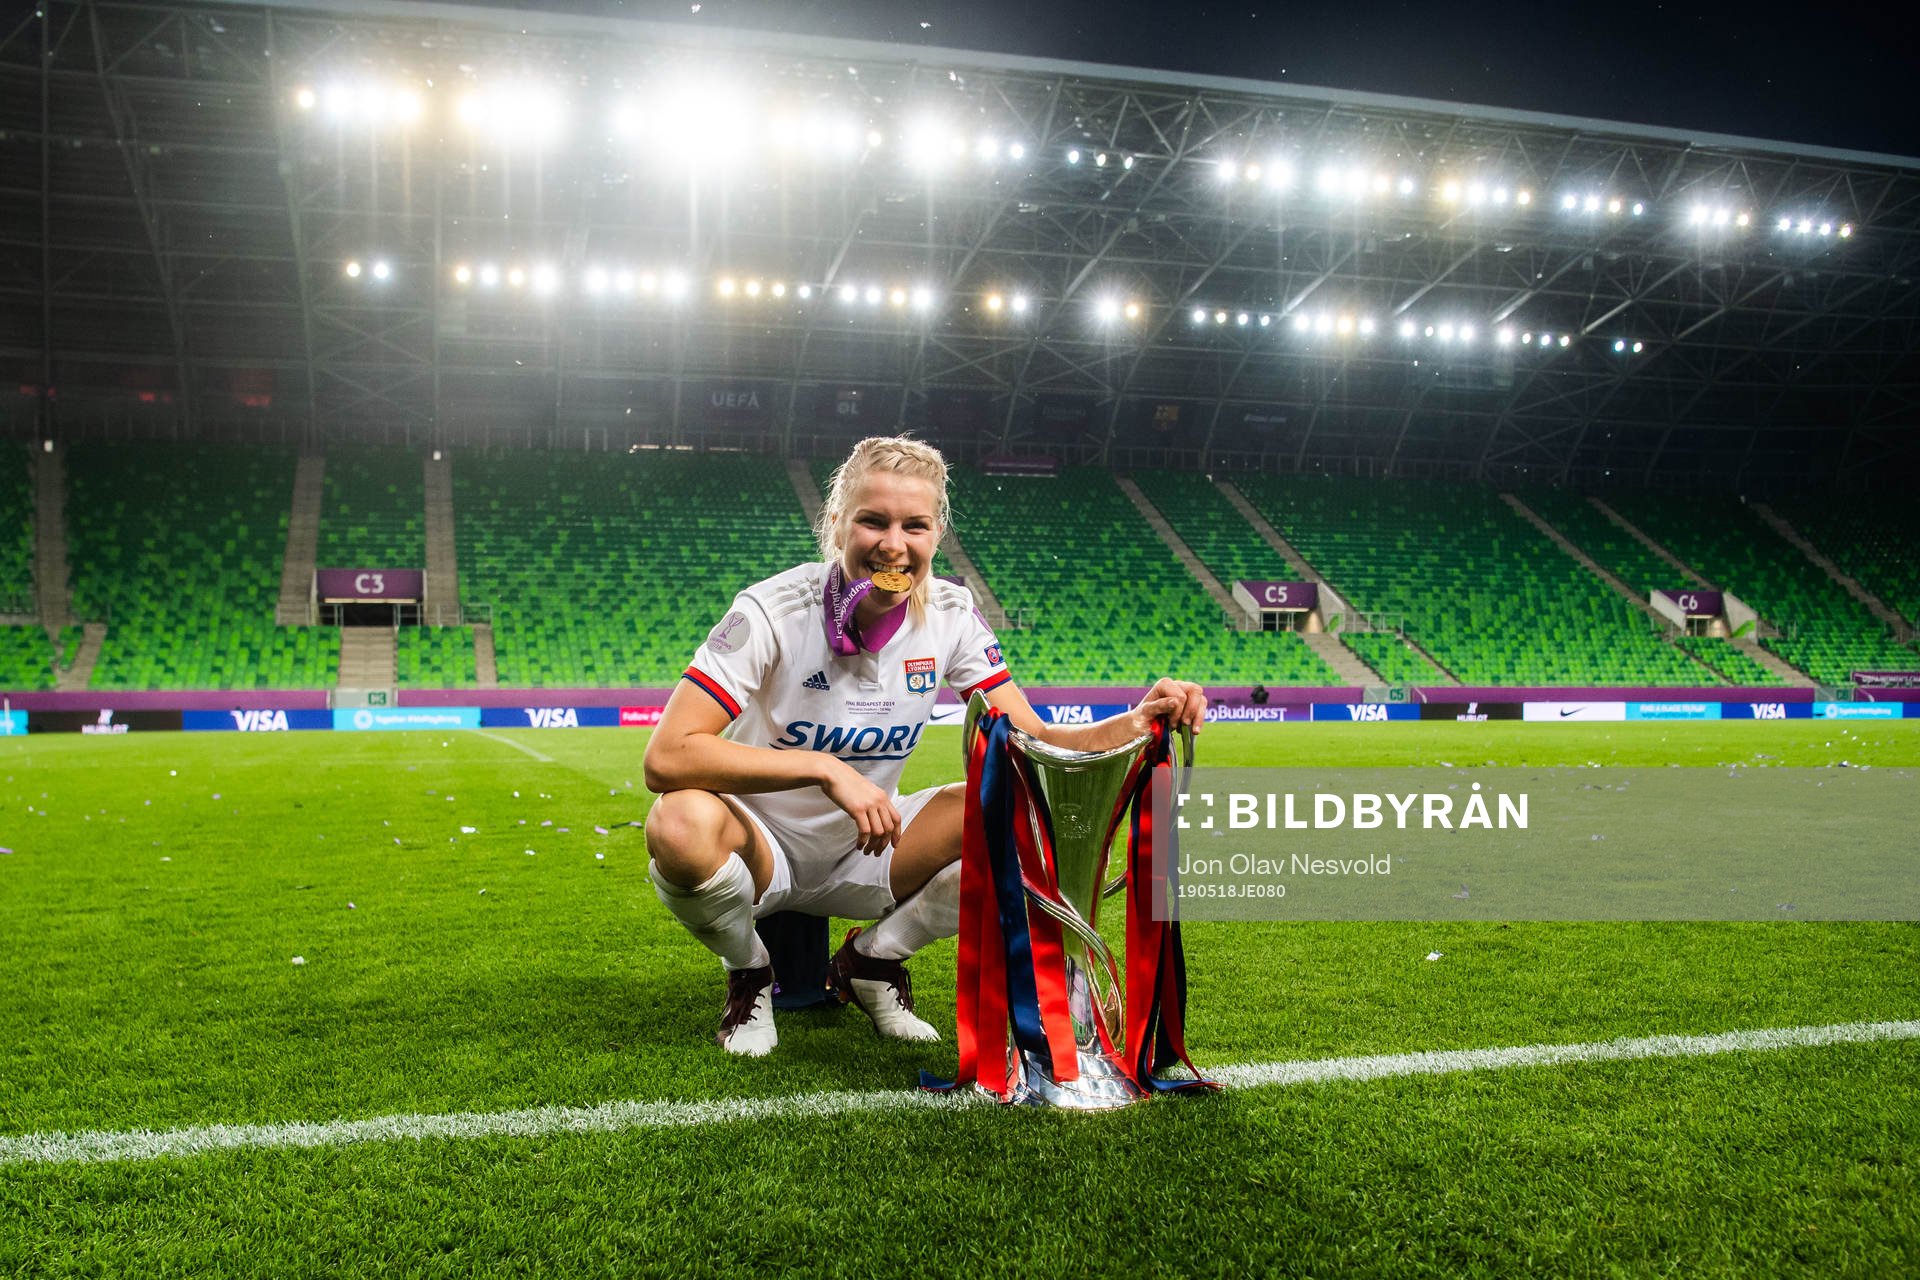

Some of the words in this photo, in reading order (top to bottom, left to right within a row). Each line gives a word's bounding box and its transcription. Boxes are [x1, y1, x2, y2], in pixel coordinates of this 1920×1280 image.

[711, 391, 760, 408] UEFA
[355, 573, 385, 594] C3
[1264, 585, 1288, 603] C5
[1679, 594, 1698, 610] C6
[802, 681, 830, 691] adidas
[1390, 688, 1404, 701] C5
[524, 708, 579, 728] VISA
[1047, 705, 1094, 723] VISA
[1346, 704, 1388, 721] VISA
[1750, 703, 1786, 719] VISA
[230, 710, 289, 731] VISA
